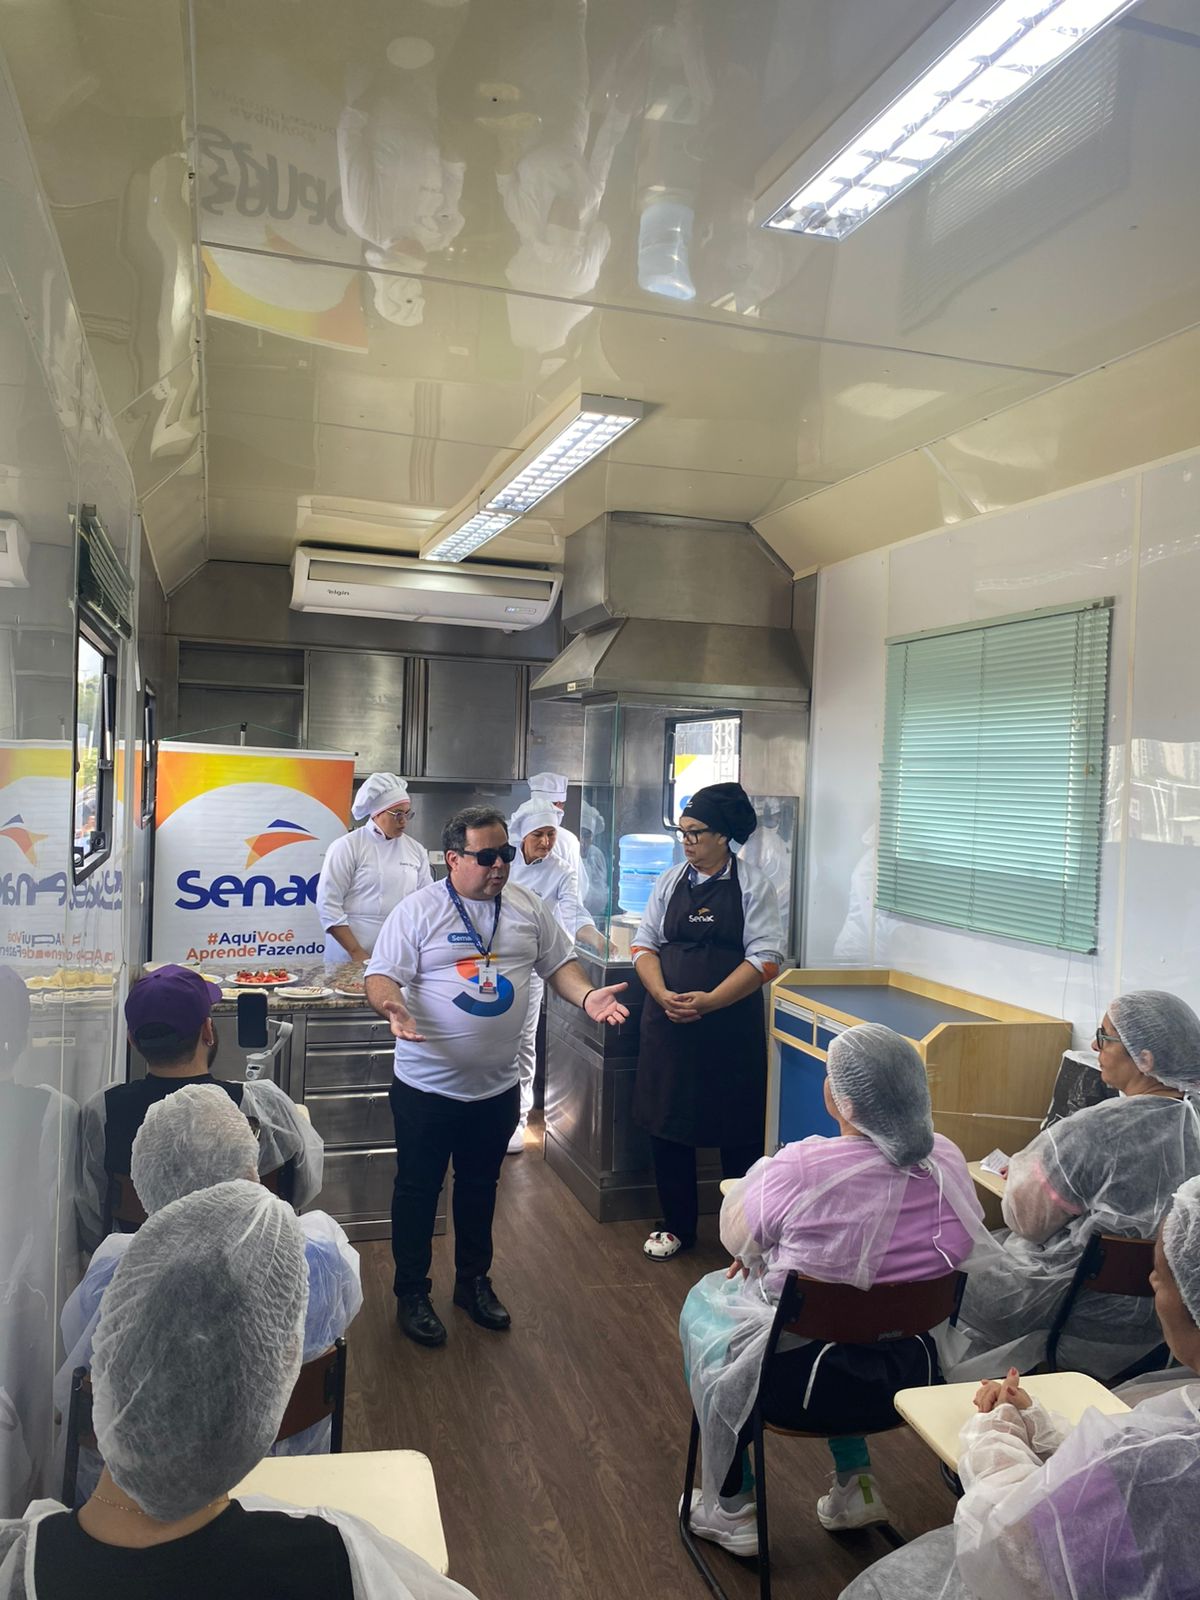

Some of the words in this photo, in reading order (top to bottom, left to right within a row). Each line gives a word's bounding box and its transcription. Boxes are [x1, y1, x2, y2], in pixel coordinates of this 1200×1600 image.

[688, 914, 715, 923] Senac
[207, 929, 295, 946] #AquiVocê
[451, 934, 473, 942] Sena
[186, 941, 326, 962] AprendeFazendo
